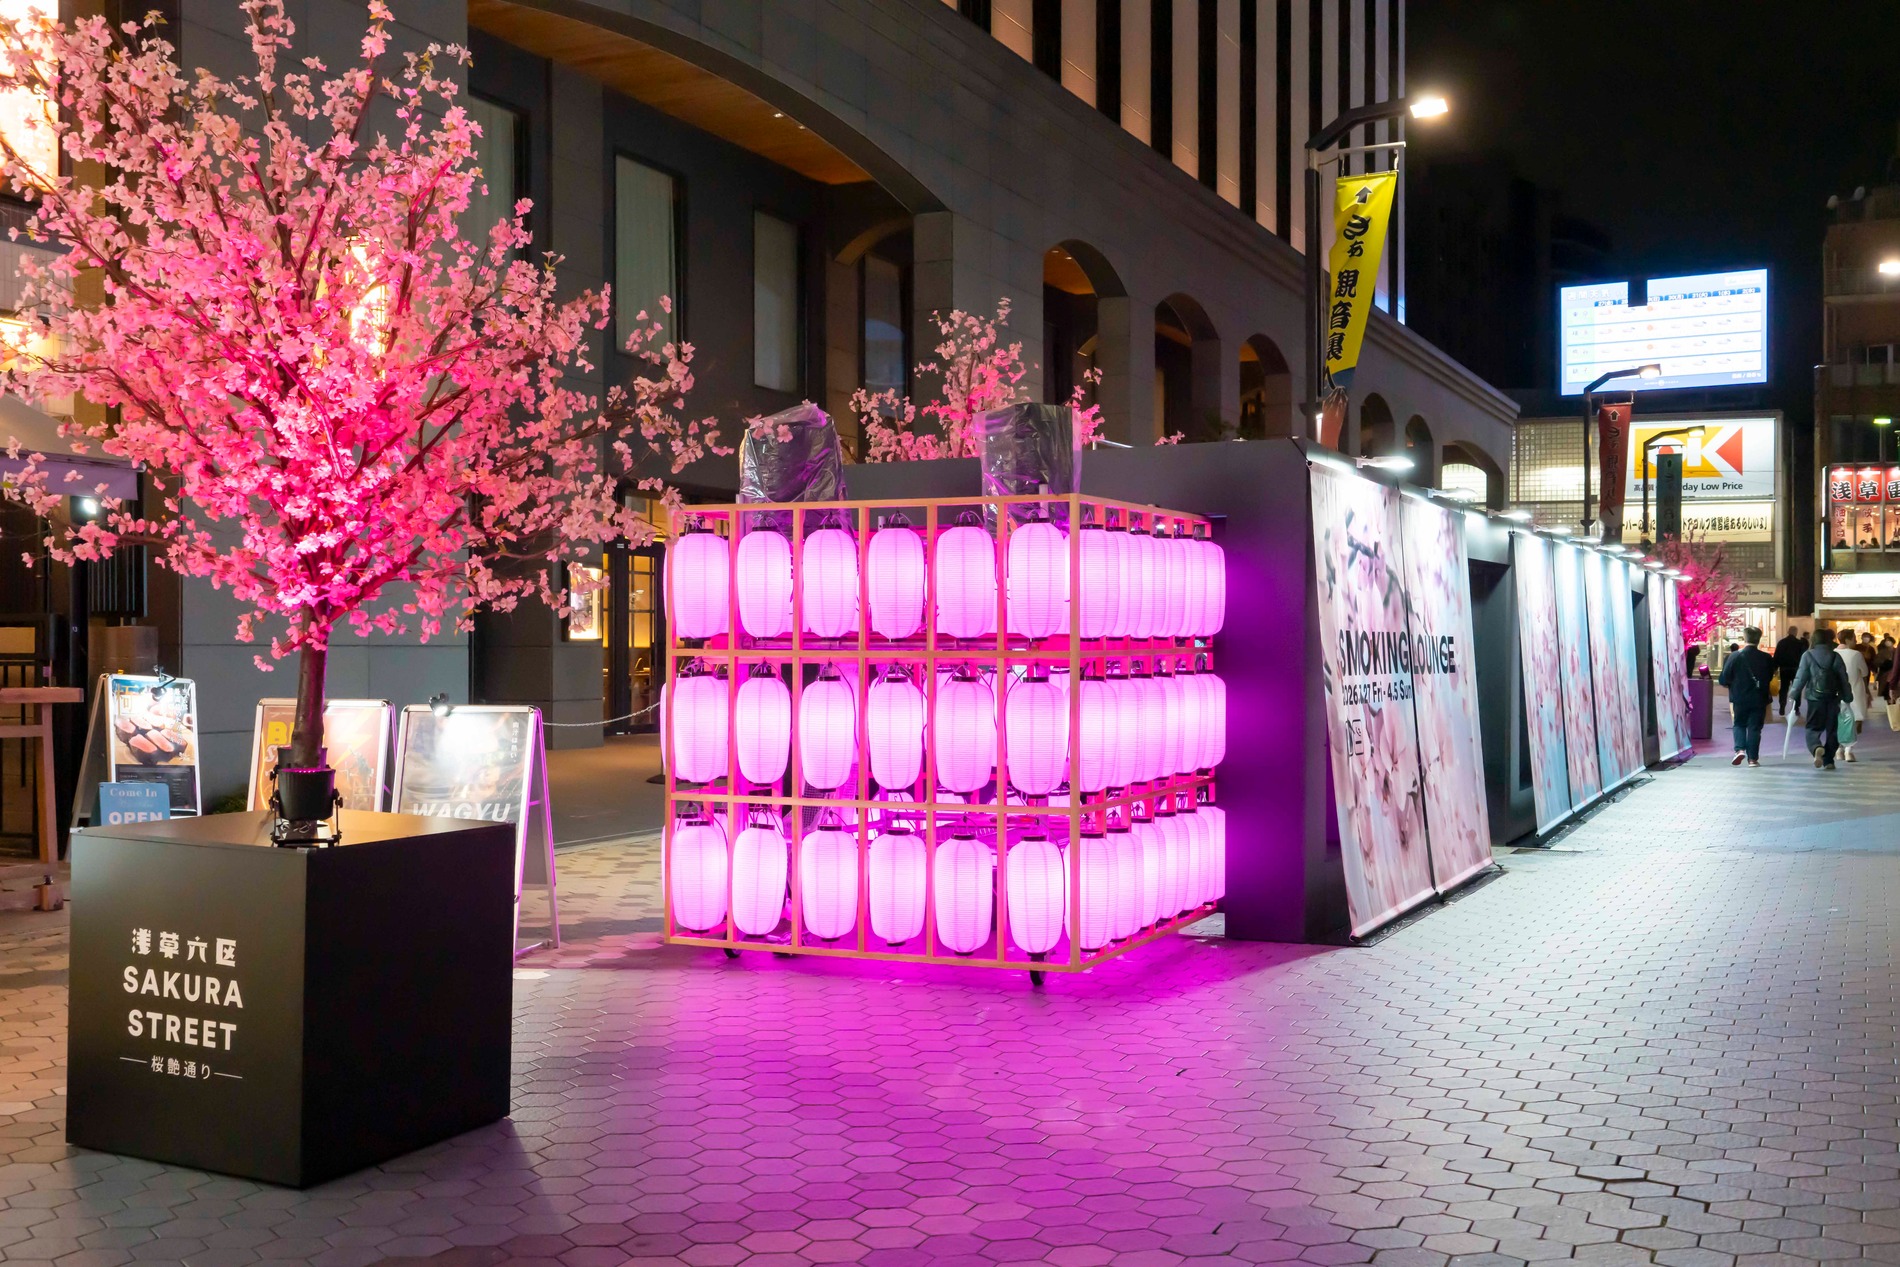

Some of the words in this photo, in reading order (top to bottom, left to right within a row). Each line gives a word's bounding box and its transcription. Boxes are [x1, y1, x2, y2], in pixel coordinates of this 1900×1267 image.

[1701, 482, 1720, 491] Low
[1722, 481, 1744, 490] Price
[1338, 629, 1410, 676] SMOKING
[1411, 634, 1456, 675] LOUNGE
[1373, 681, 1383, 703] Fri
[1387, 681, 1399, 702] 4.5
[1400, 679, 1412, 701] Sun
[110, 788, 142, 797] Come
[145, 788, 158, 797] In
[108, 811, 163, 826] OPEN
[412, 802, 511, 822] WAGYU
[132, 928, 237, 967] 浅草六区
[123, 965, 243, 1009] SAKURA
[127, 1009, 237, 1051] STREET
[150, 1055, 211, 1080] 桜艶通り
